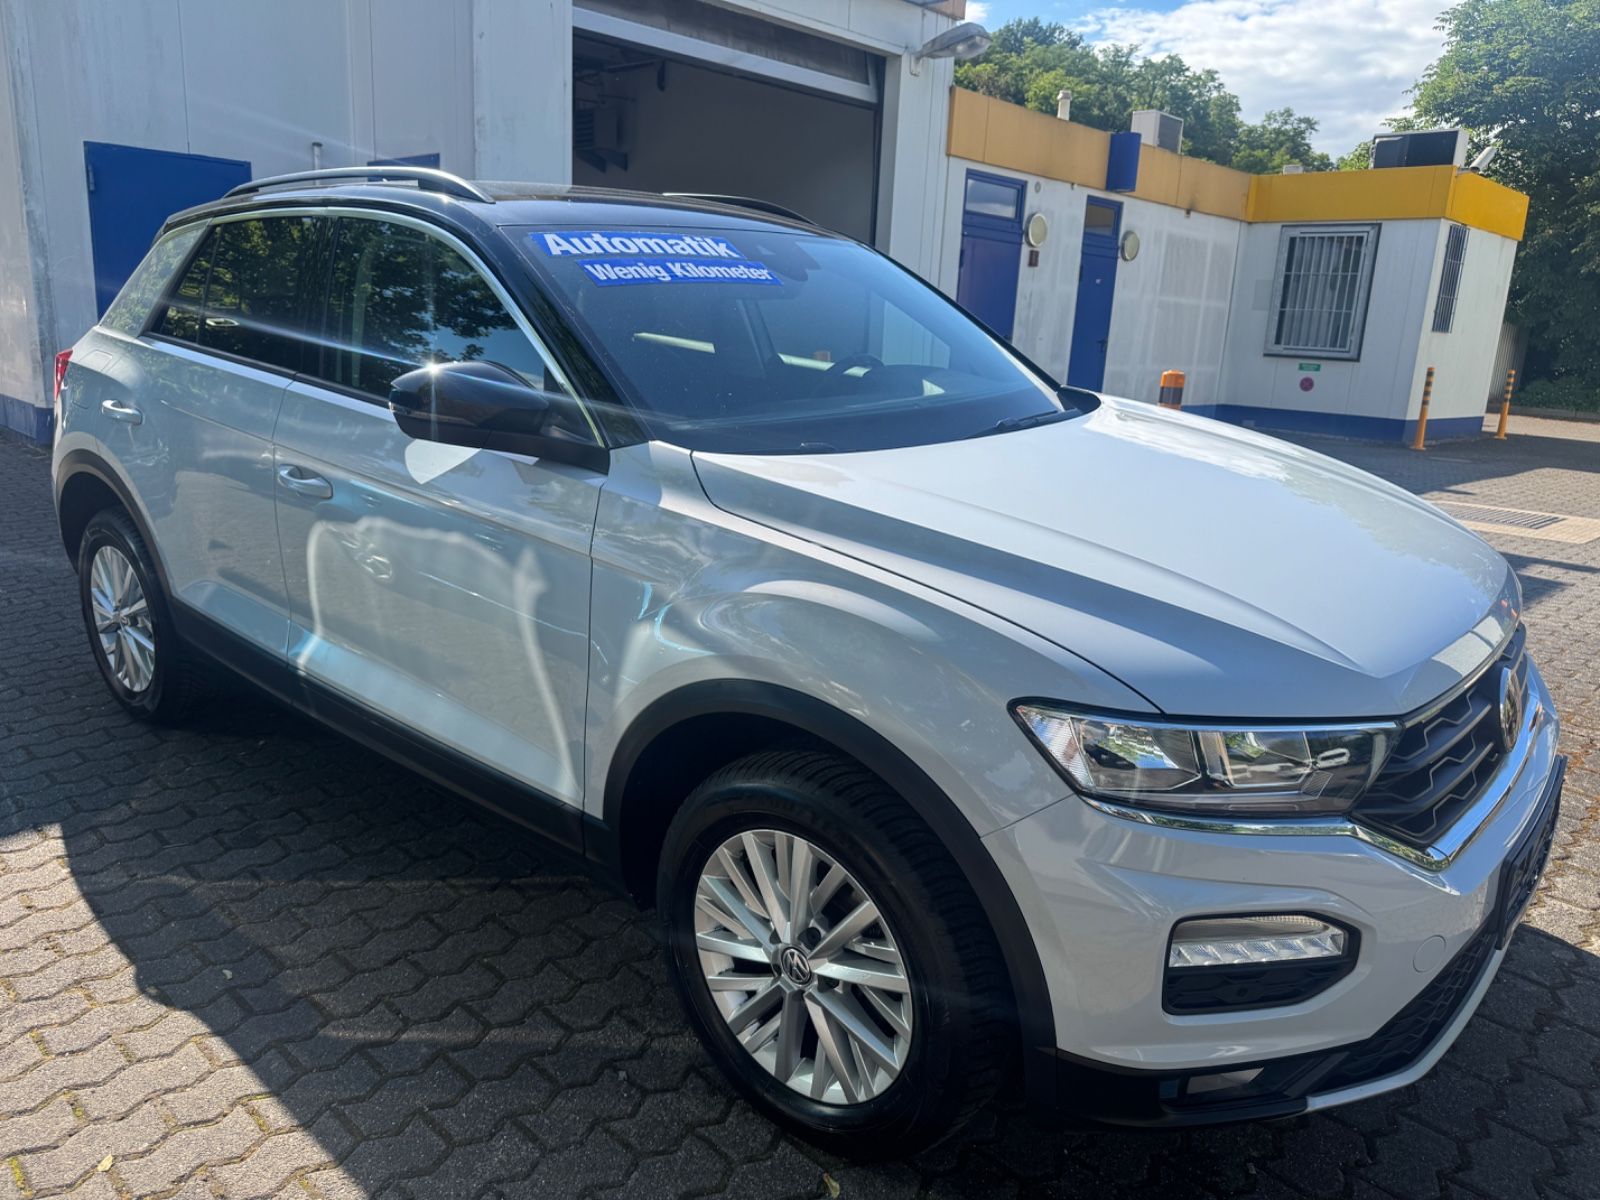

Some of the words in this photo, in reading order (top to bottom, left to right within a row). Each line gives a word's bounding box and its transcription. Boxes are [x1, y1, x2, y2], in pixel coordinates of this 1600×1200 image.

[543, 233, 740, 258] Automatik
[584, 262, 671, 281] Wenig
[666, 262, 773, 280] Kilometer
